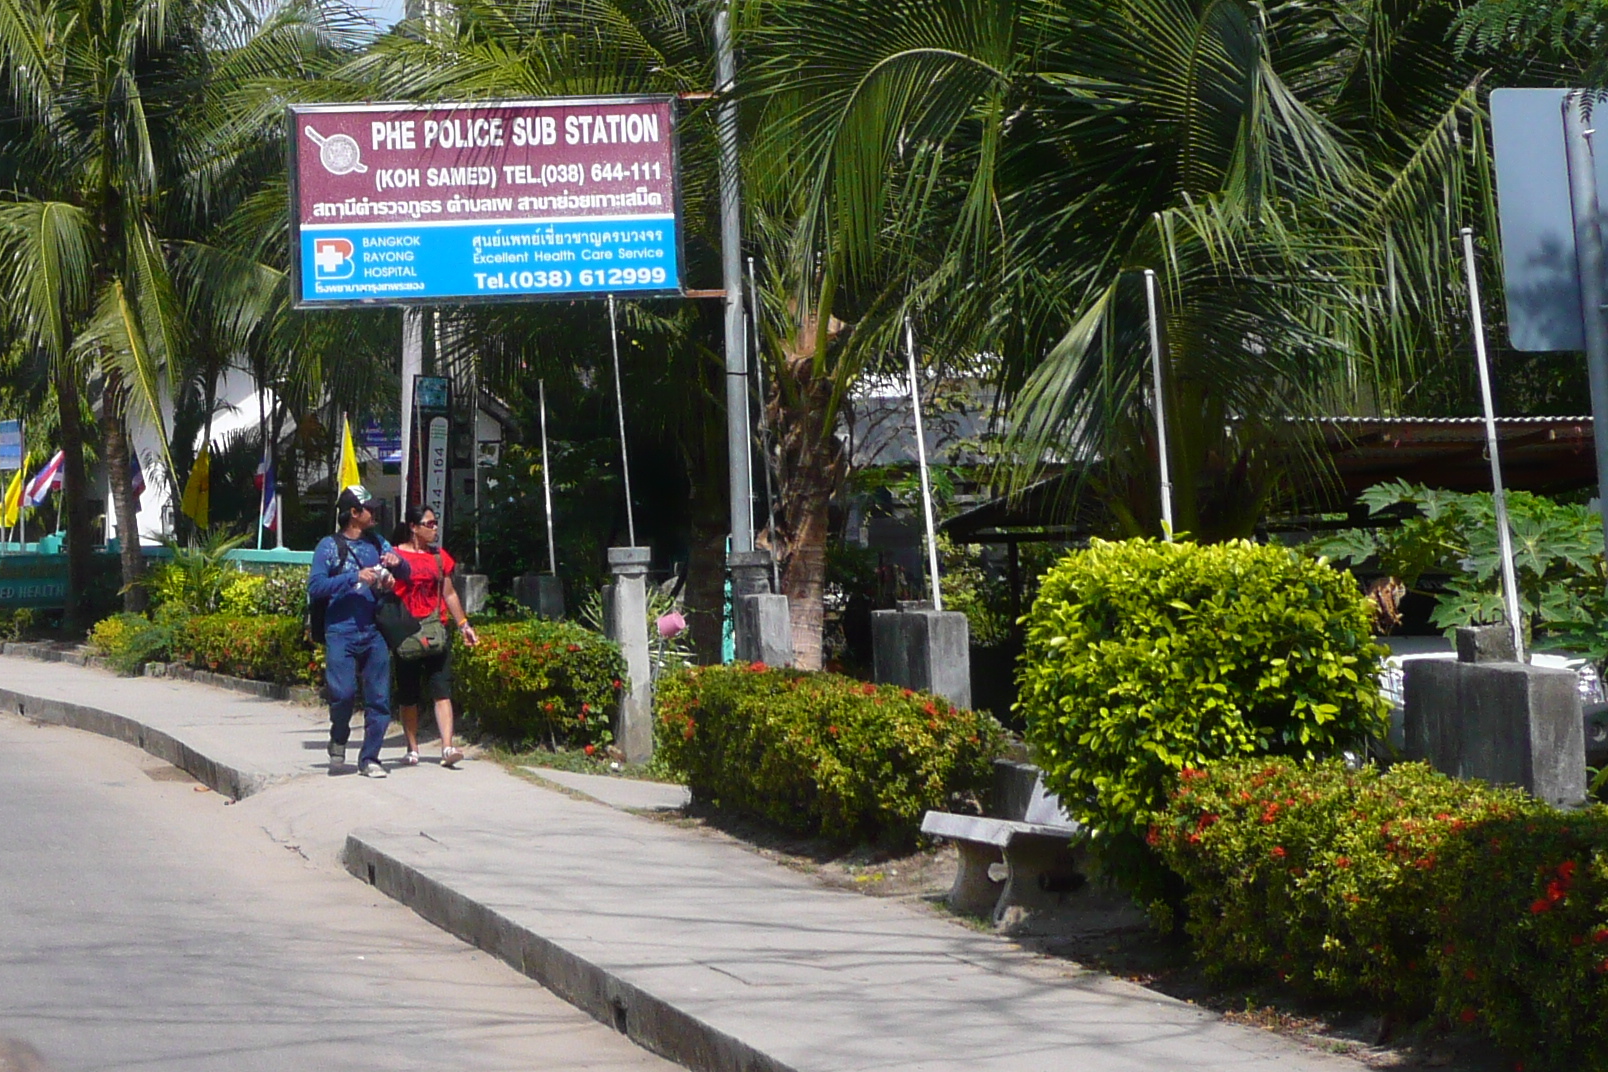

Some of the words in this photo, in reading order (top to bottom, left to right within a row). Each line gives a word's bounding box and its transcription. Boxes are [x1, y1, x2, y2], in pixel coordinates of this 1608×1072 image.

[372, 121, 416, 150] PHE
[424, 118, 503, 150] POLICE
[512, 116, 556, 146] SUB
[565, 114, 659, 144] STATION
[376, 169, 420, 192] (KOH
[427, 166, 497, 189] SAMED)
[591, 161, 661, 182] 644-111
[313, 197, 442, 218] สถานีตำรวจภูธร
[362, 236, 421, 248] BANGKOK
[363, 251, 414, 263] RAYONG
[473, 252, 529, 264] Excellent
[534, 250, 576, 262] Health
[581, 249, 613, 261] Care
[618, 247, 664, 259] Service
[364, 267, 417, 278] HOSPITAL
[473, 270, 572, 289] Tel.(038)
[579, 267, 666, 286] 612999
